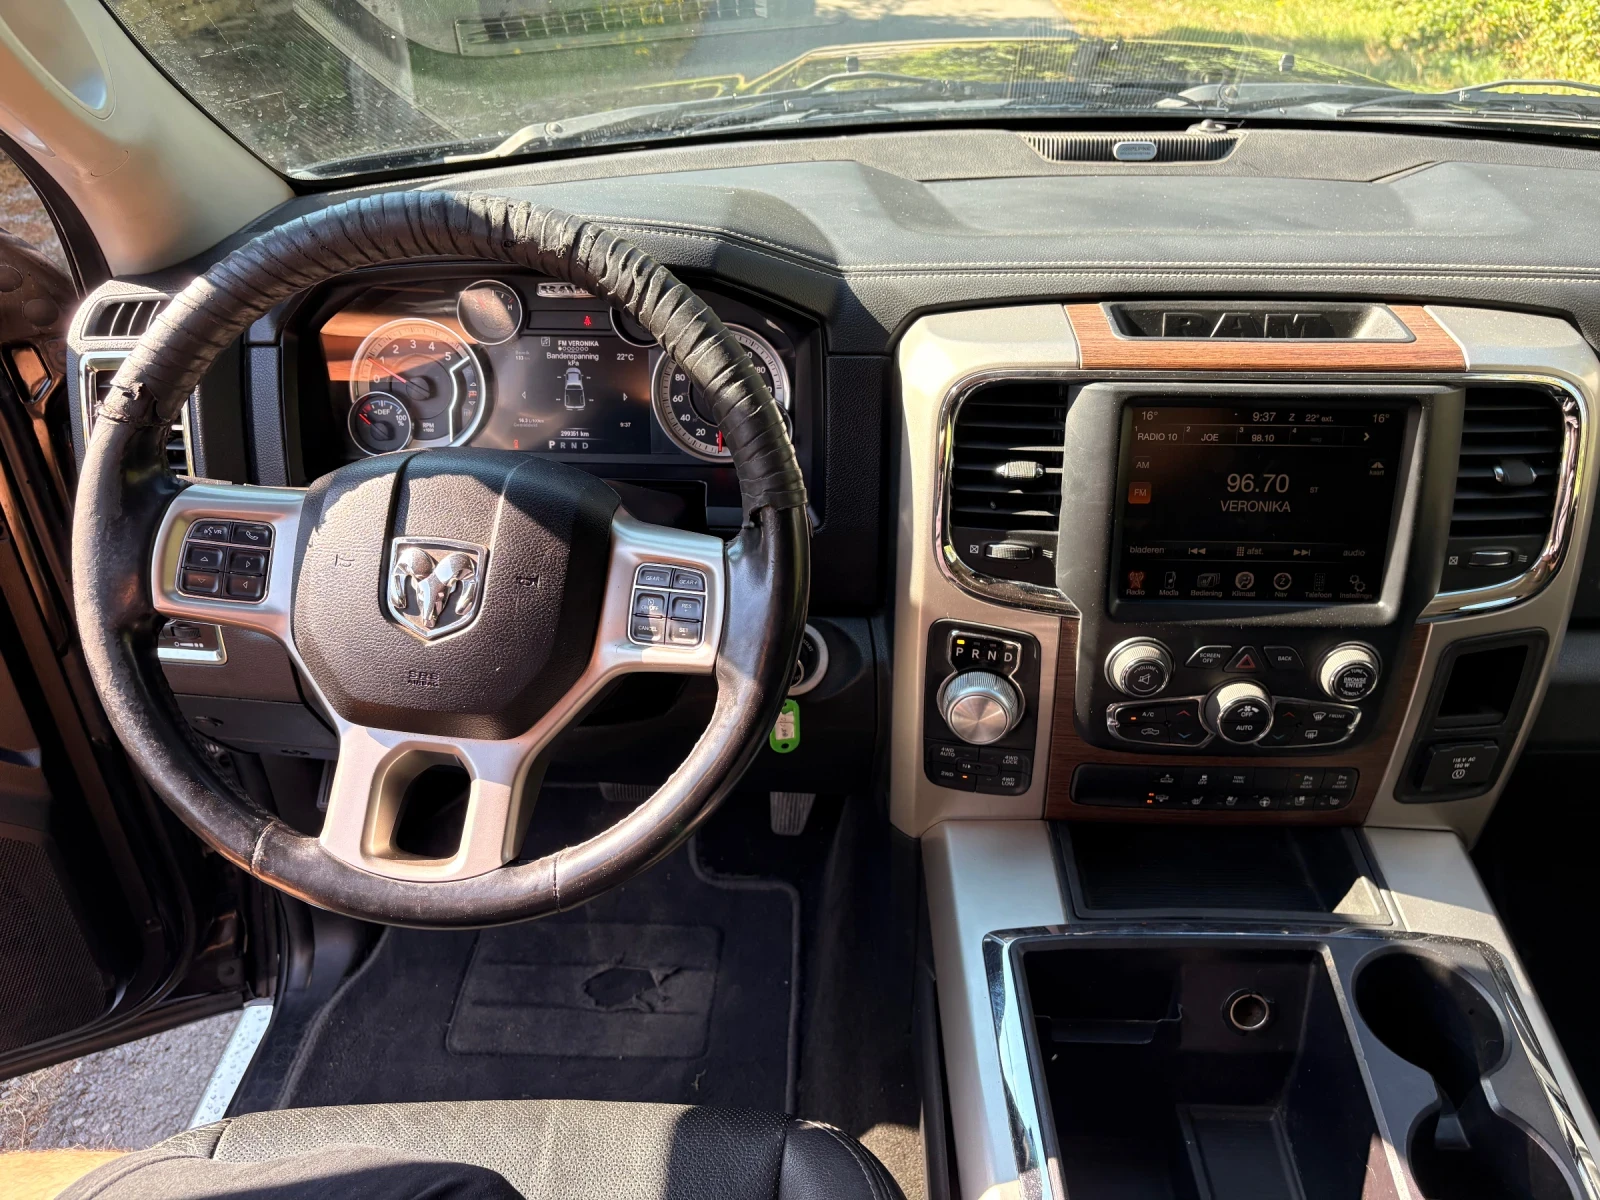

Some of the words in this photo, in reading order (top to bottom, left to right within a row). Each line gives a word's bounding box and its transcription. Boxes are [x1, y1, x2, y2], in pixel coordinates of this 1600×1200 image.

[1161, 312, 1326, 338] RAM
[546, 352, 600, 362] Bandenspanning
[373, 374, 381, 384] 0
[380, 356, 385, 364] 1
[392, 344, 400, 354] 2
[410, 340, 417, 349] 3
[428, 342, 436, 351] 4
[444, 352, 452, 361] 5
[1252, 411, 1276, 422] 9:37
[1372, 414, 1390, 423] 16°
[696, 428, 706, 436] 20
[1137, 432, 1165, 441] RADIO
[1168, 433, 1178, 441] 10
[1200, 433, 1219, 442] JOE
[1252, 434, 1275, 442] 98.10
[548, 440, 556, 449] P
[1226, 474, 1290, 493] 96.70
[1134, 488, 1147, 496] FM
[1220, 500, 1291, 513] VERONIKA
[1129, 546, 1165, 554] bladeren
[1342, 549, 1366, 557] audio
[1190, 590, 1223, 598] Bediening
[956, 646, 964, 657] P
[971, 650, 980, 659] R
[987, 651, 997, 660] N
[1004, 652, 1013, 662] D
